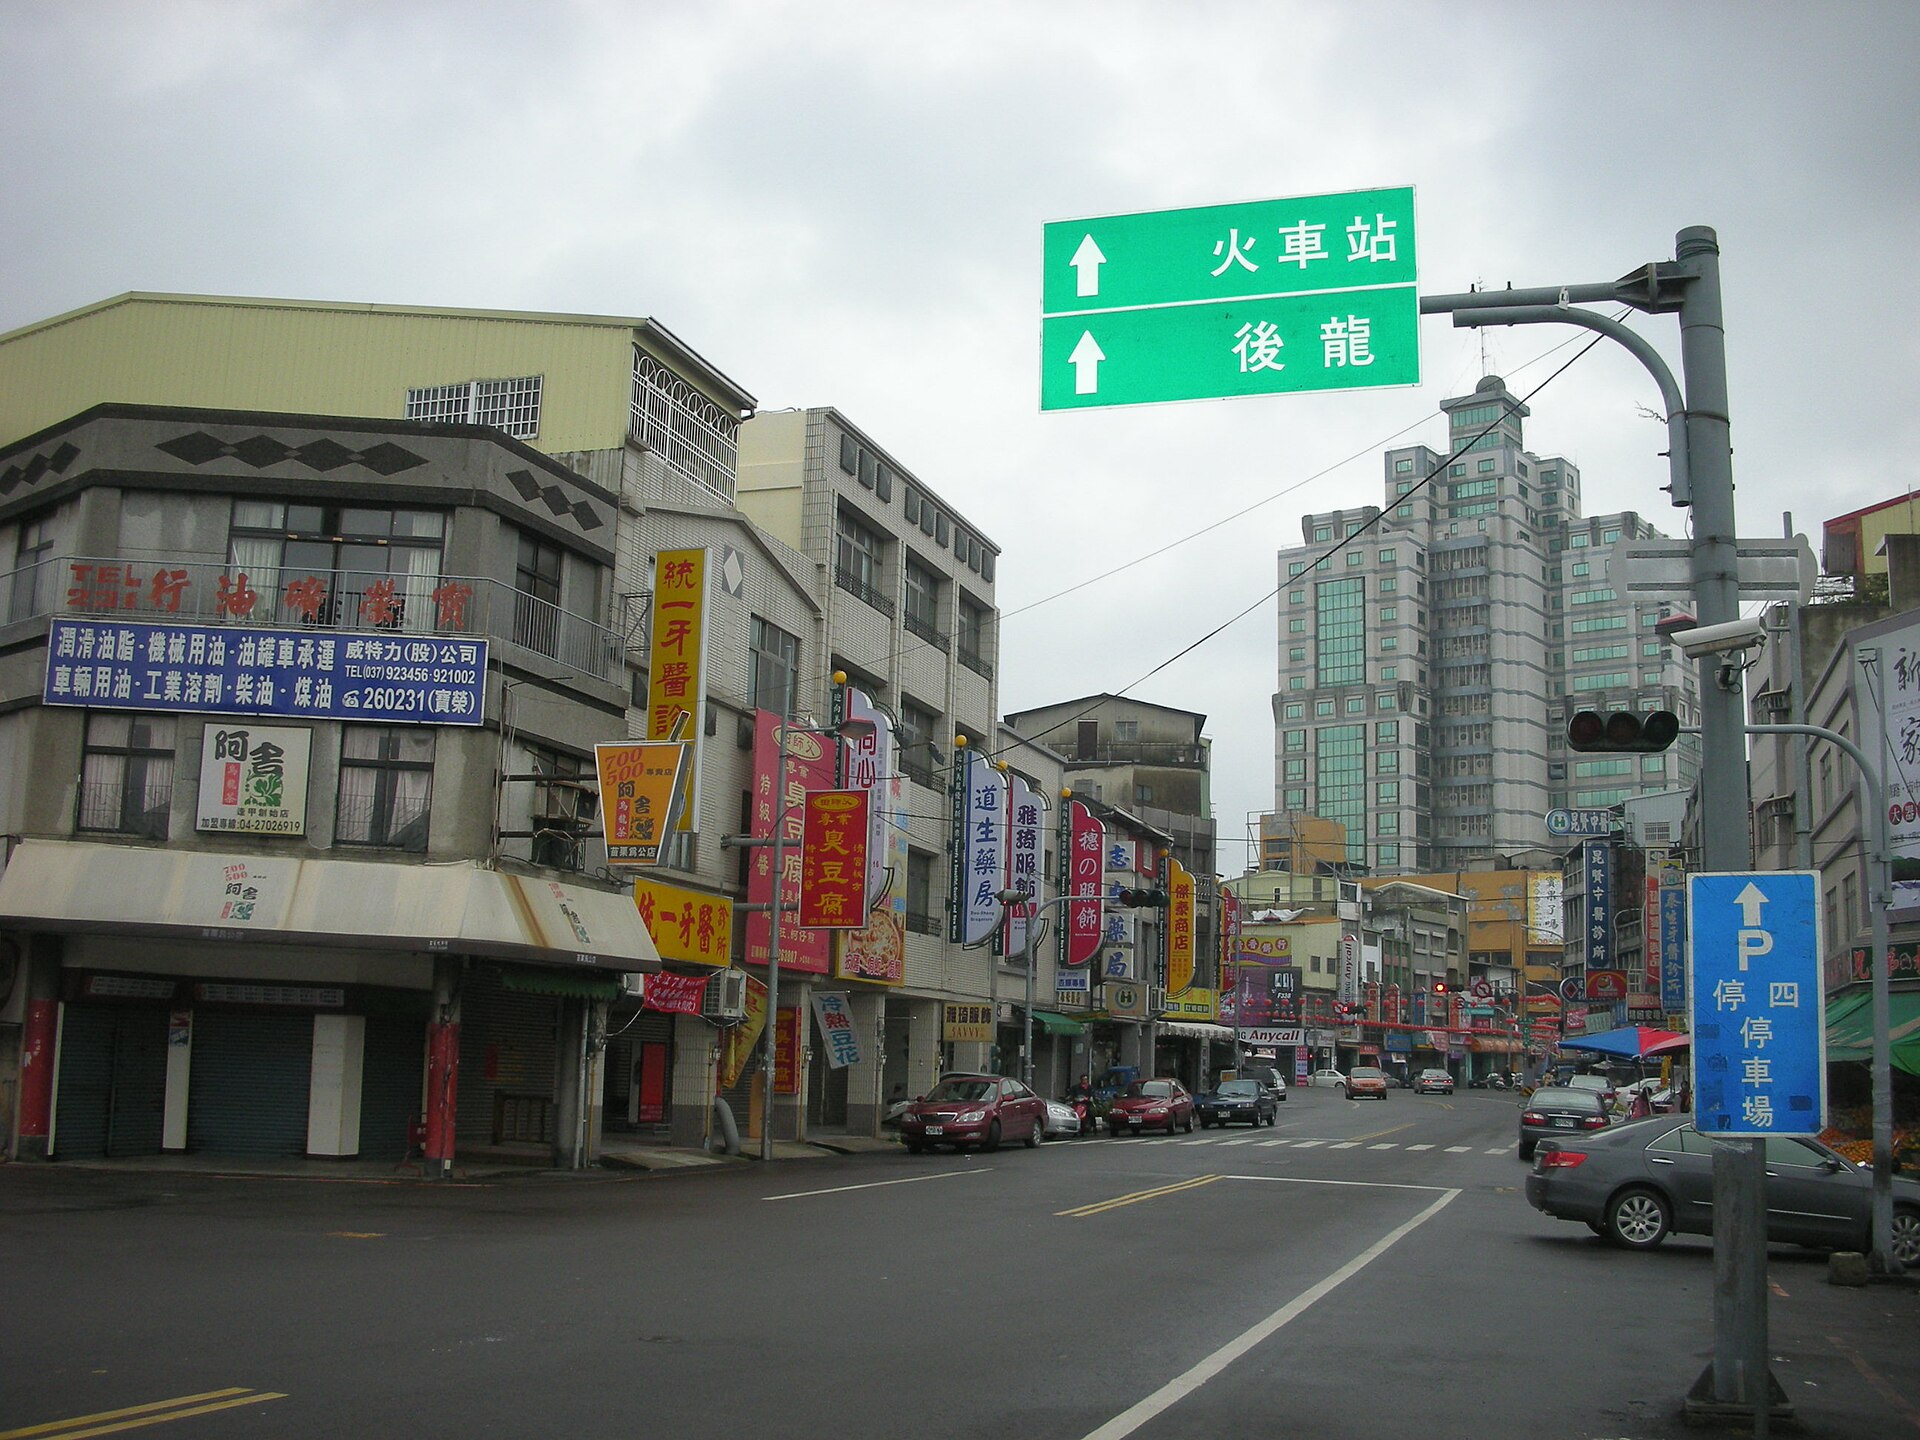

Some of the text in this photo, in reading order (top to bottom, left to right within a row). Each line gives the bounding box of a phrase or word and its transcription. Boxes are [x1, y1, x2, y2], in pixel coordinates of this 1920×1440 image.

[1211, 213, 1397, 277] 火車站
[1231, 314, 1375, 373] 後龍
[70, 564, 142, 588] TEL
[345, 640, 478, 665] 威特力(股)公司
[605, 747, 643, 771] 700
[605, 762, 644, 786] 500
[616, 801, 628, 838] 烏龍茶
[818, 812, 852, 826] 專業
[973, 785, 999, 907] 道生藥房
[814, 829, 850, 915] 臭豆腐
[1345, 943, 1353, 979] Anycall
[1738, 929, 1774, 972] P
[819, 995, 860, 1065] 冷熱豆花
[1249, 1030, 1300, 1042] Anycall
[1740, 1016, 1774, 1128] 停車場
